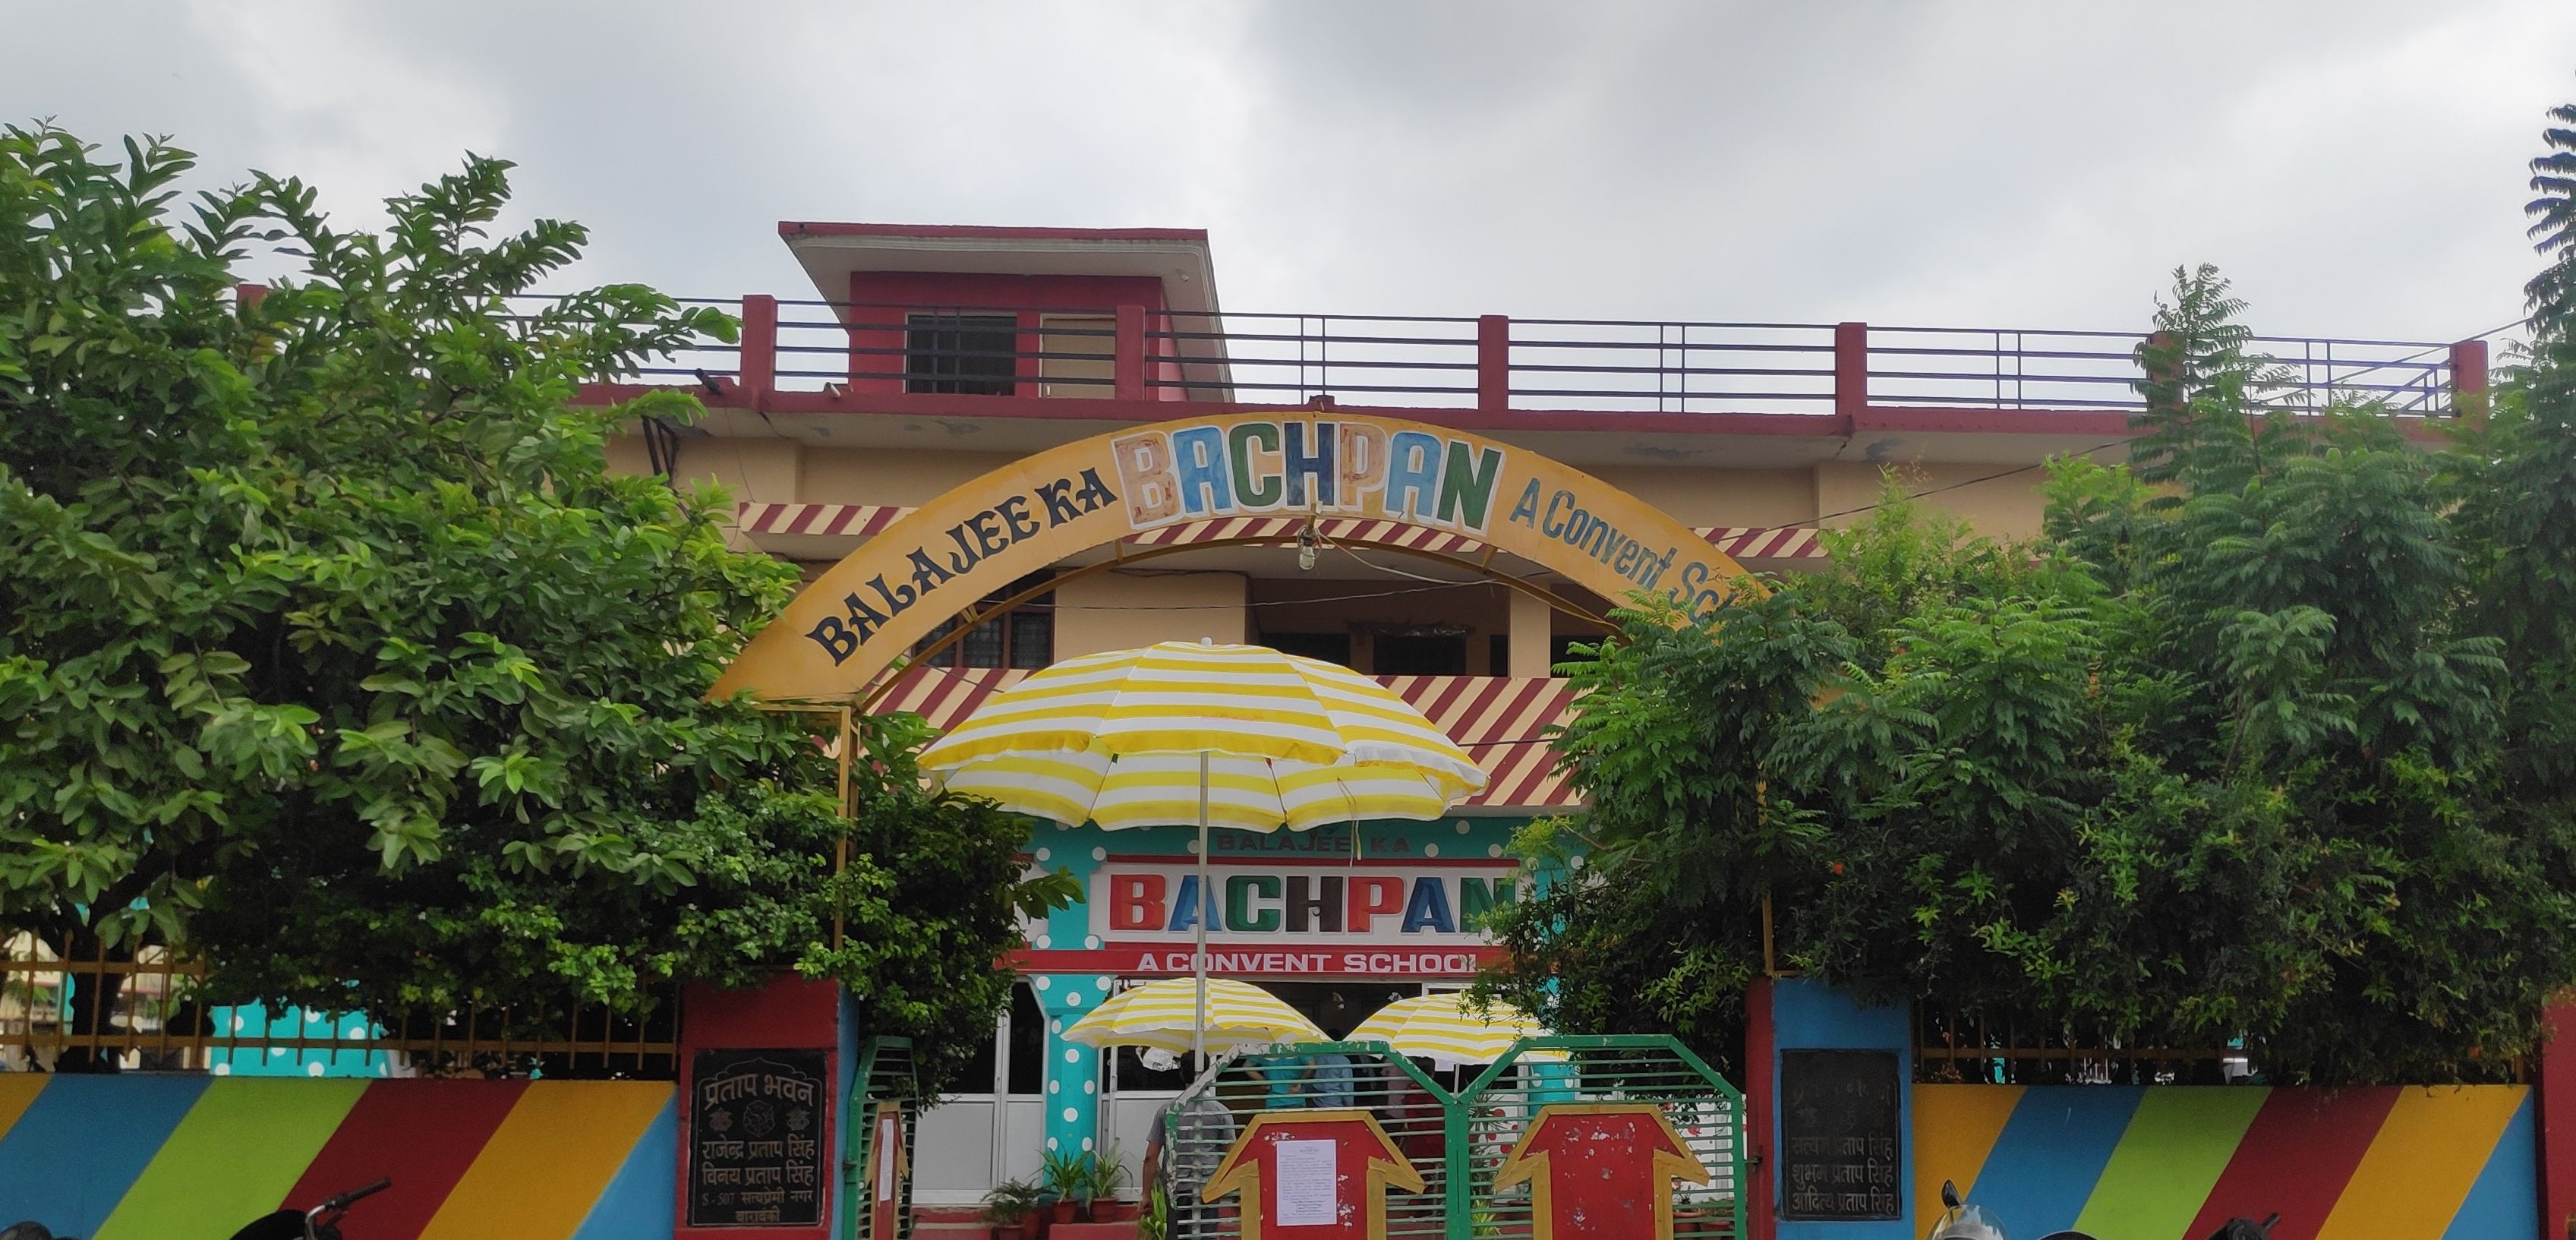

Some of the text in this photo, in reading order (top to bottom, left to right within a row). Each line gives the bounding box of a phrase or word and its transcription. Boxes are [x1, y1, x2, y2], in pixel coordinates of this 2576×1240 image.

[806, 495, 1041, 667] BALAJEE
[1033, 466, 1118, 529] KA
[1111, 420, 1506, 536] BACHPAN
[1510, 477, 1540, 529] A
[1542, 491, 1678, 592] Convent
[1216, 831, 1411, 853] BALAJEE KA
[1109, 874, 1517, 933] BACHPAN
[1137, 953, 1486, 973] A CONVENT SCHOOL
[704, 1074, 815, 1111] प्रताप भवन
[702, 1133, 815, 1160] राजेन्द्र प्रताप सिंह
[702, 1160, 815, 1186] विनय प्रताप सिंह
[1831, 1163, 1864, 1184] प्रताप
[790, 1191, 814, 1203] नगर
[1792, 1185, 1834, 1211] आदित्य
[1837, 1193, 1868, 1213] प्रताप
